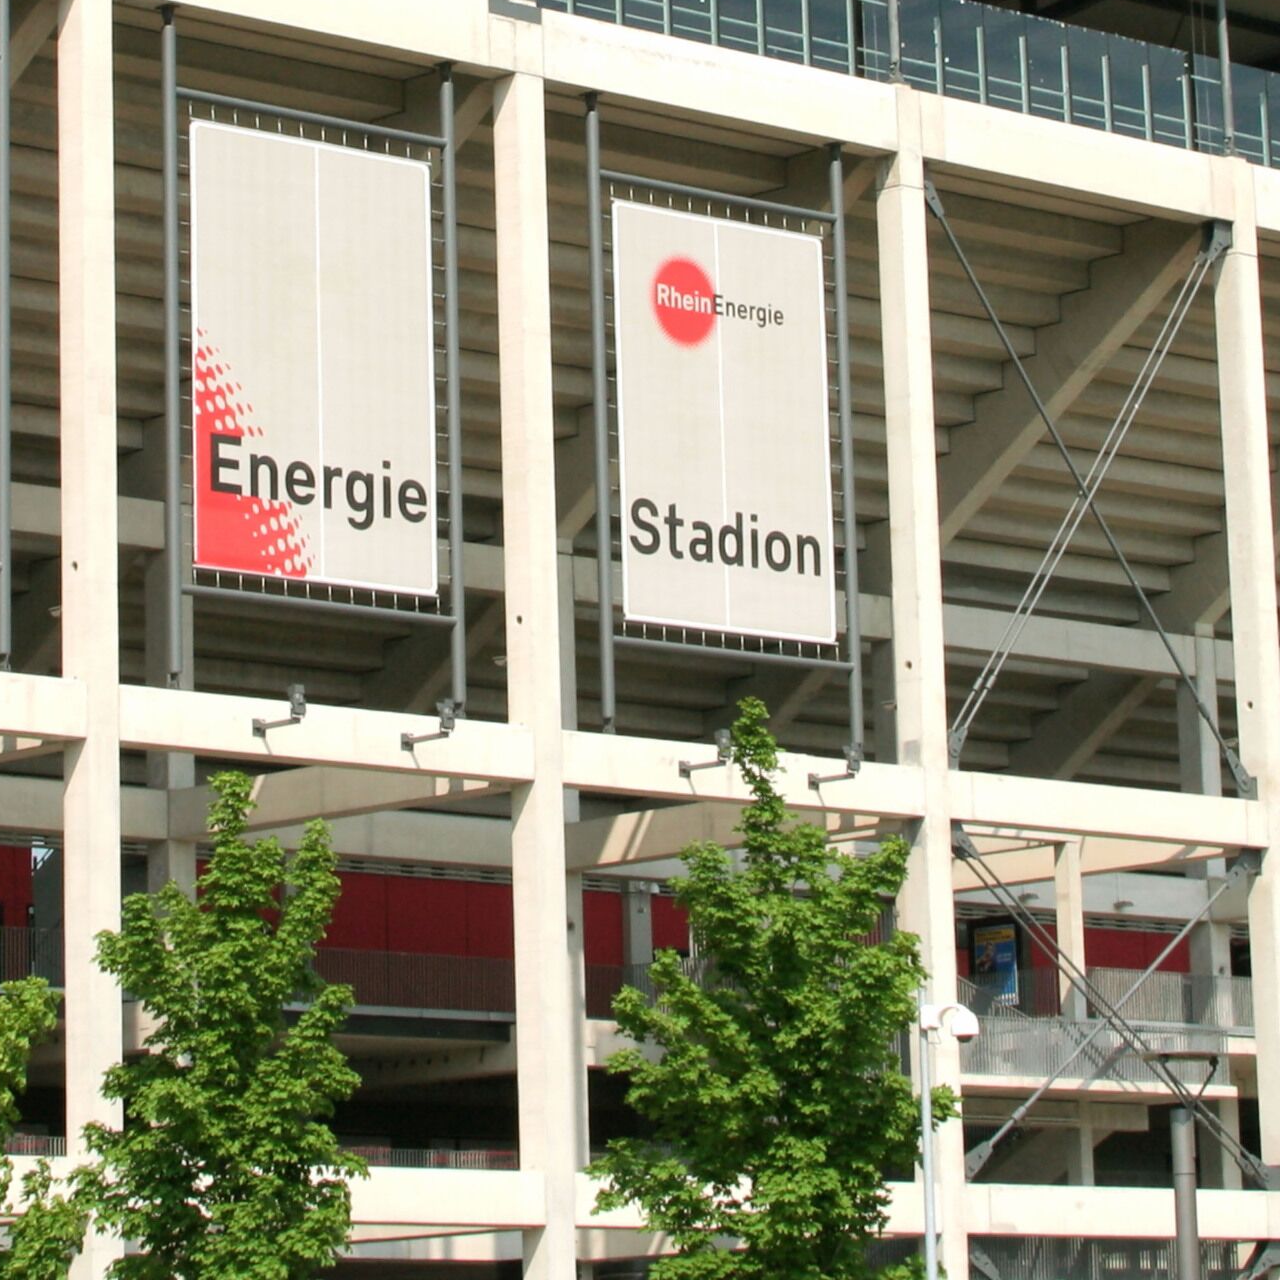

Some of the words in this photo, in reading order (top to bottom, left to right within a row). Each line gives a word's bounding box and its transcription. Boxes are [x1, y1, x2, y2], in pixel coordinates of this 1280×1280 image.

[656, 283, 784, 328] RheinEnergie
[210, 432, 428, 531] Energie
[629, 497, 821, 577] Stadion
